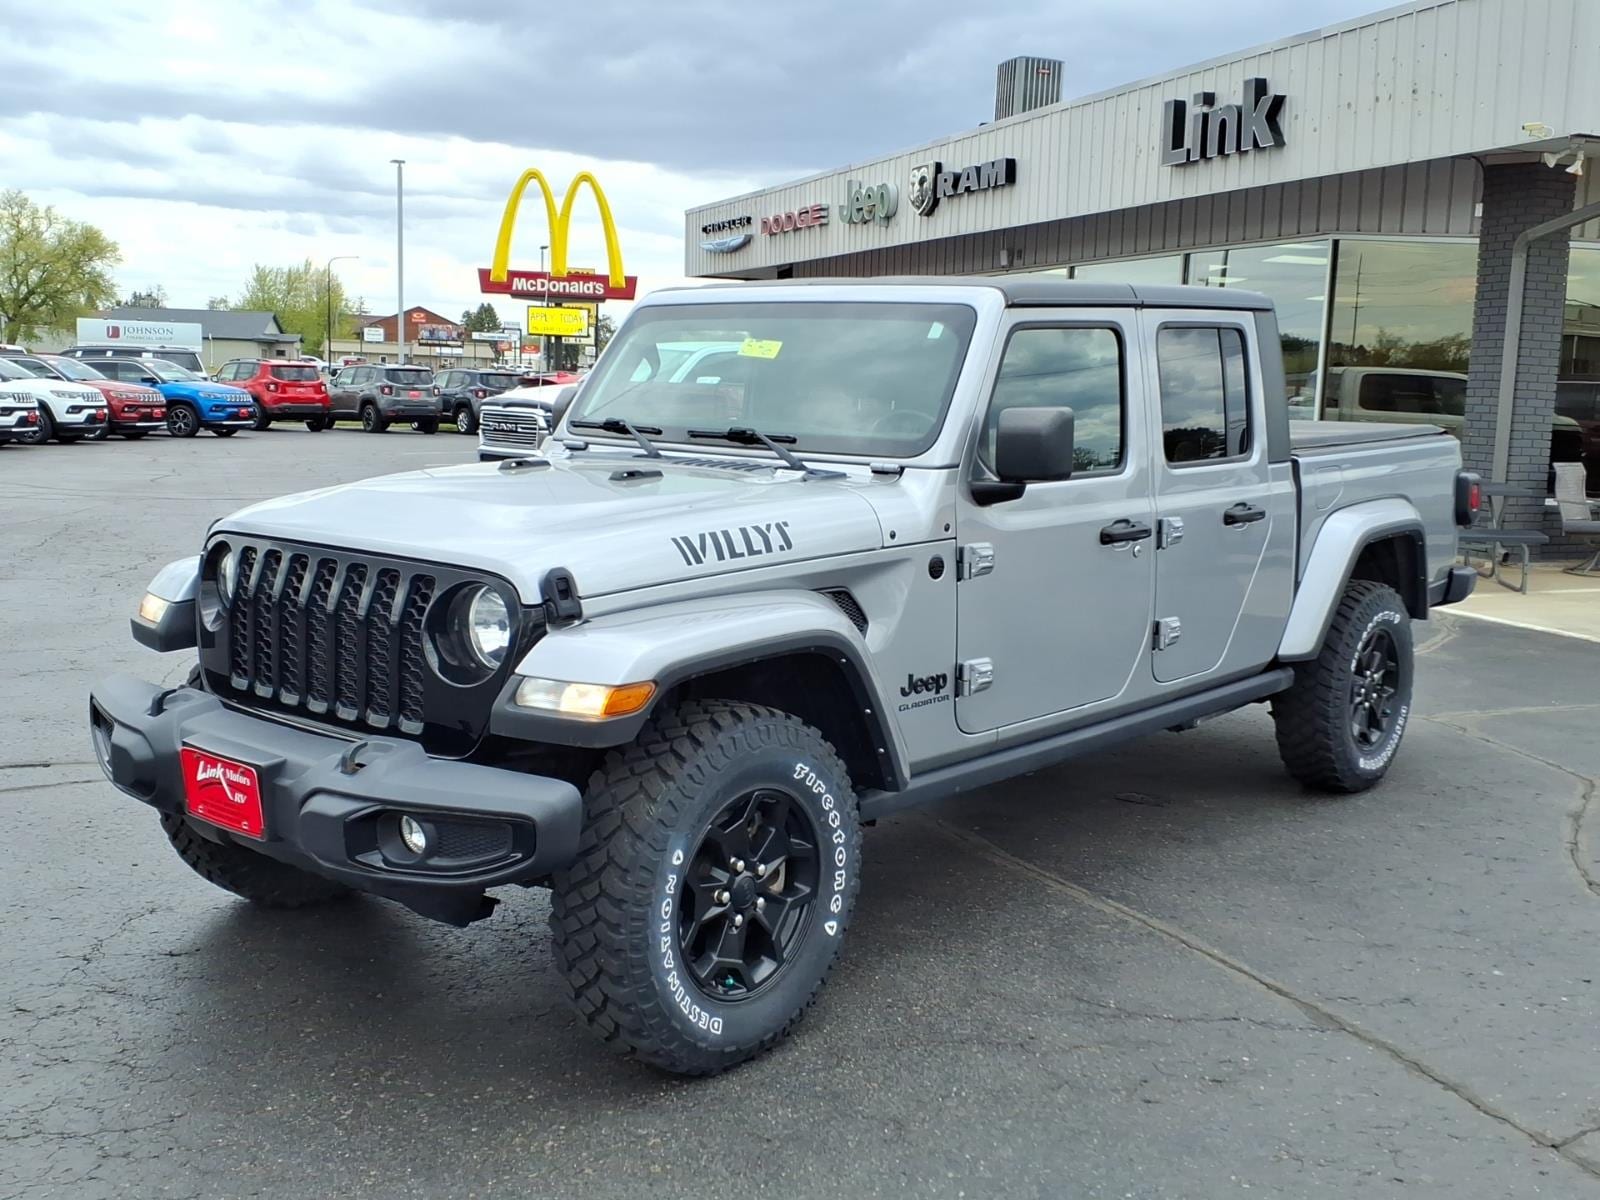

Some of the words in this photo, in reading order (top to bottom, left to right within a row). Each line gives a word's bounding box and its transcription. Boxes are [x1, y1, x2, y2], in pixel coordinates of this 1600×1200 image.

[1162, 77, 1286, 167] Link
[936, 158, 1015, 199] RAM
[839, 180, 897, 228] Jeep
[760, 203, 827, 236] DODGE
[512, 277, 605, 295] McDonald's
[123, 325, 174, 336] JOHNSON
[491, 422, 516, 431] RAM
[670, 521, 793, 566] WILLYS
[899, 672, 948, 697] Jeep
[898, 694, 950, 712] GLADIATOR
[225, 768, 251, 786] Motors
[234, 792, 247, 804] RV
[660, 875, 723, 1035] DESTINATION
